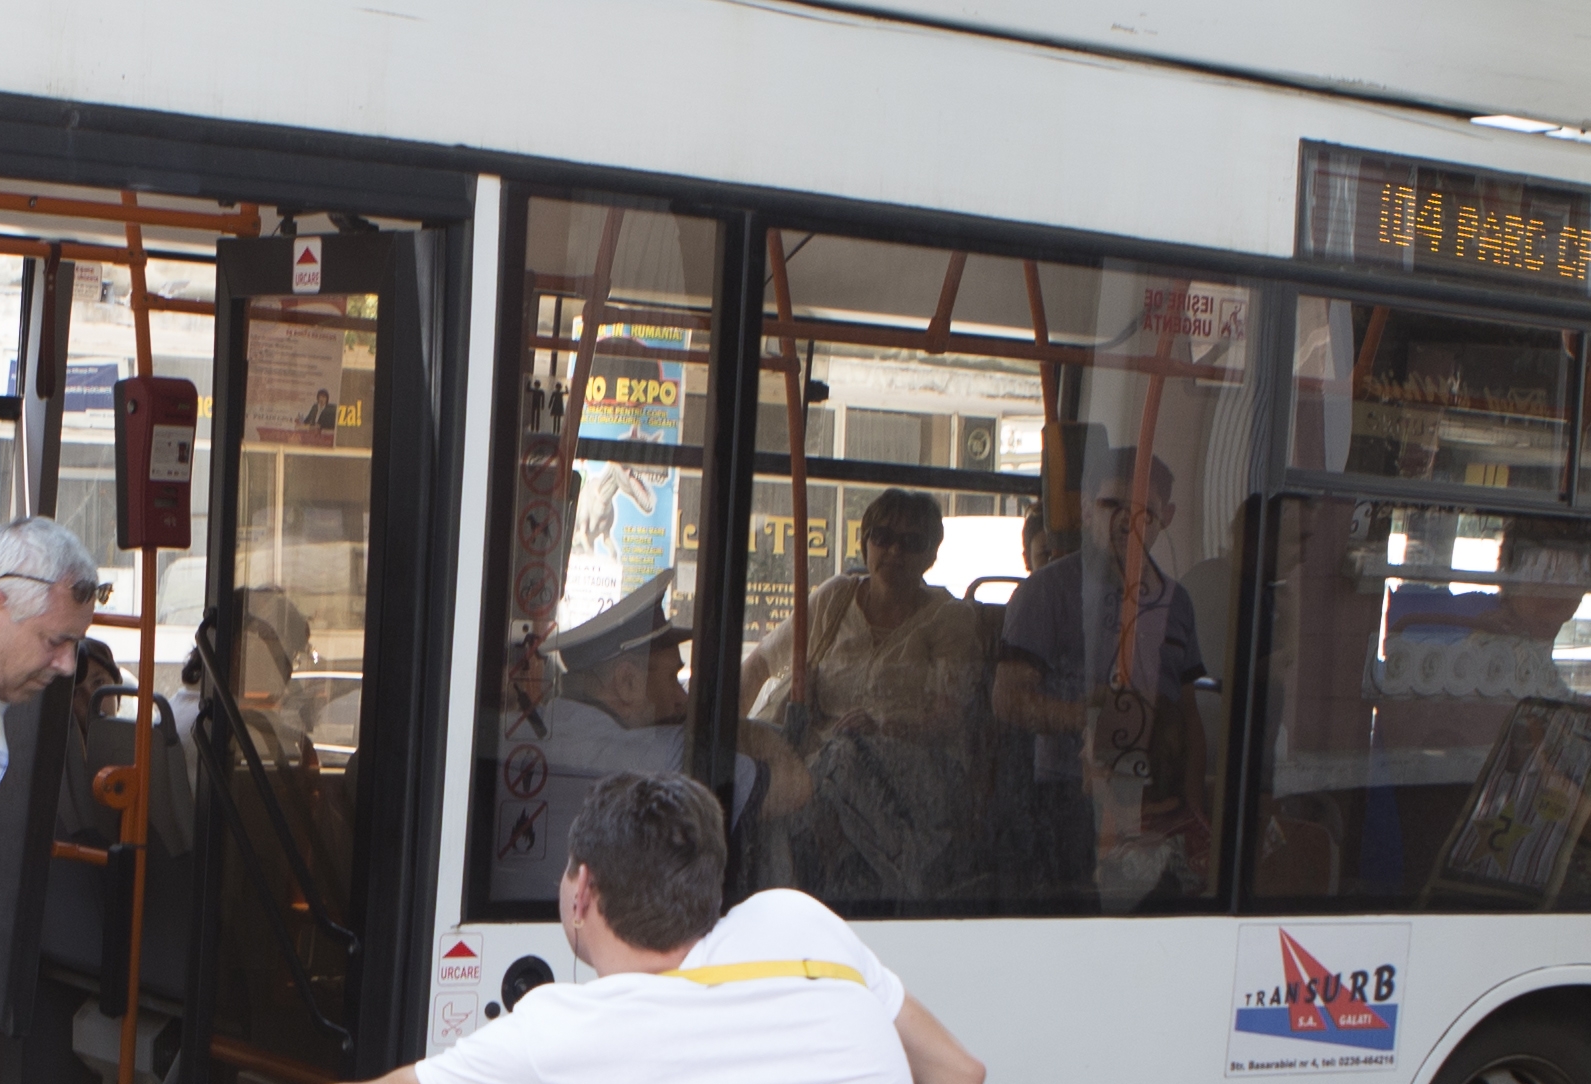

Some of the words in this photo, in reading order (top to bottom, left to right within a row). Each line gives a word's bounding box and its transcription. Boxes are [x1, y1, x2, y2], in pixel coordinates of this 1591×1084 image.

[1379, 183, 1443, 252] 104
[1456, 205, 1546, 271] PARC
[295, 271, 320, 287] URCARE
[615, 376, 677, 406] EXPO
[440, 965, 481, 980] URCARE
[1244, 963, 1397, 1007] TRANSURB
[1229, 1061, 1246, 1071] Str.
